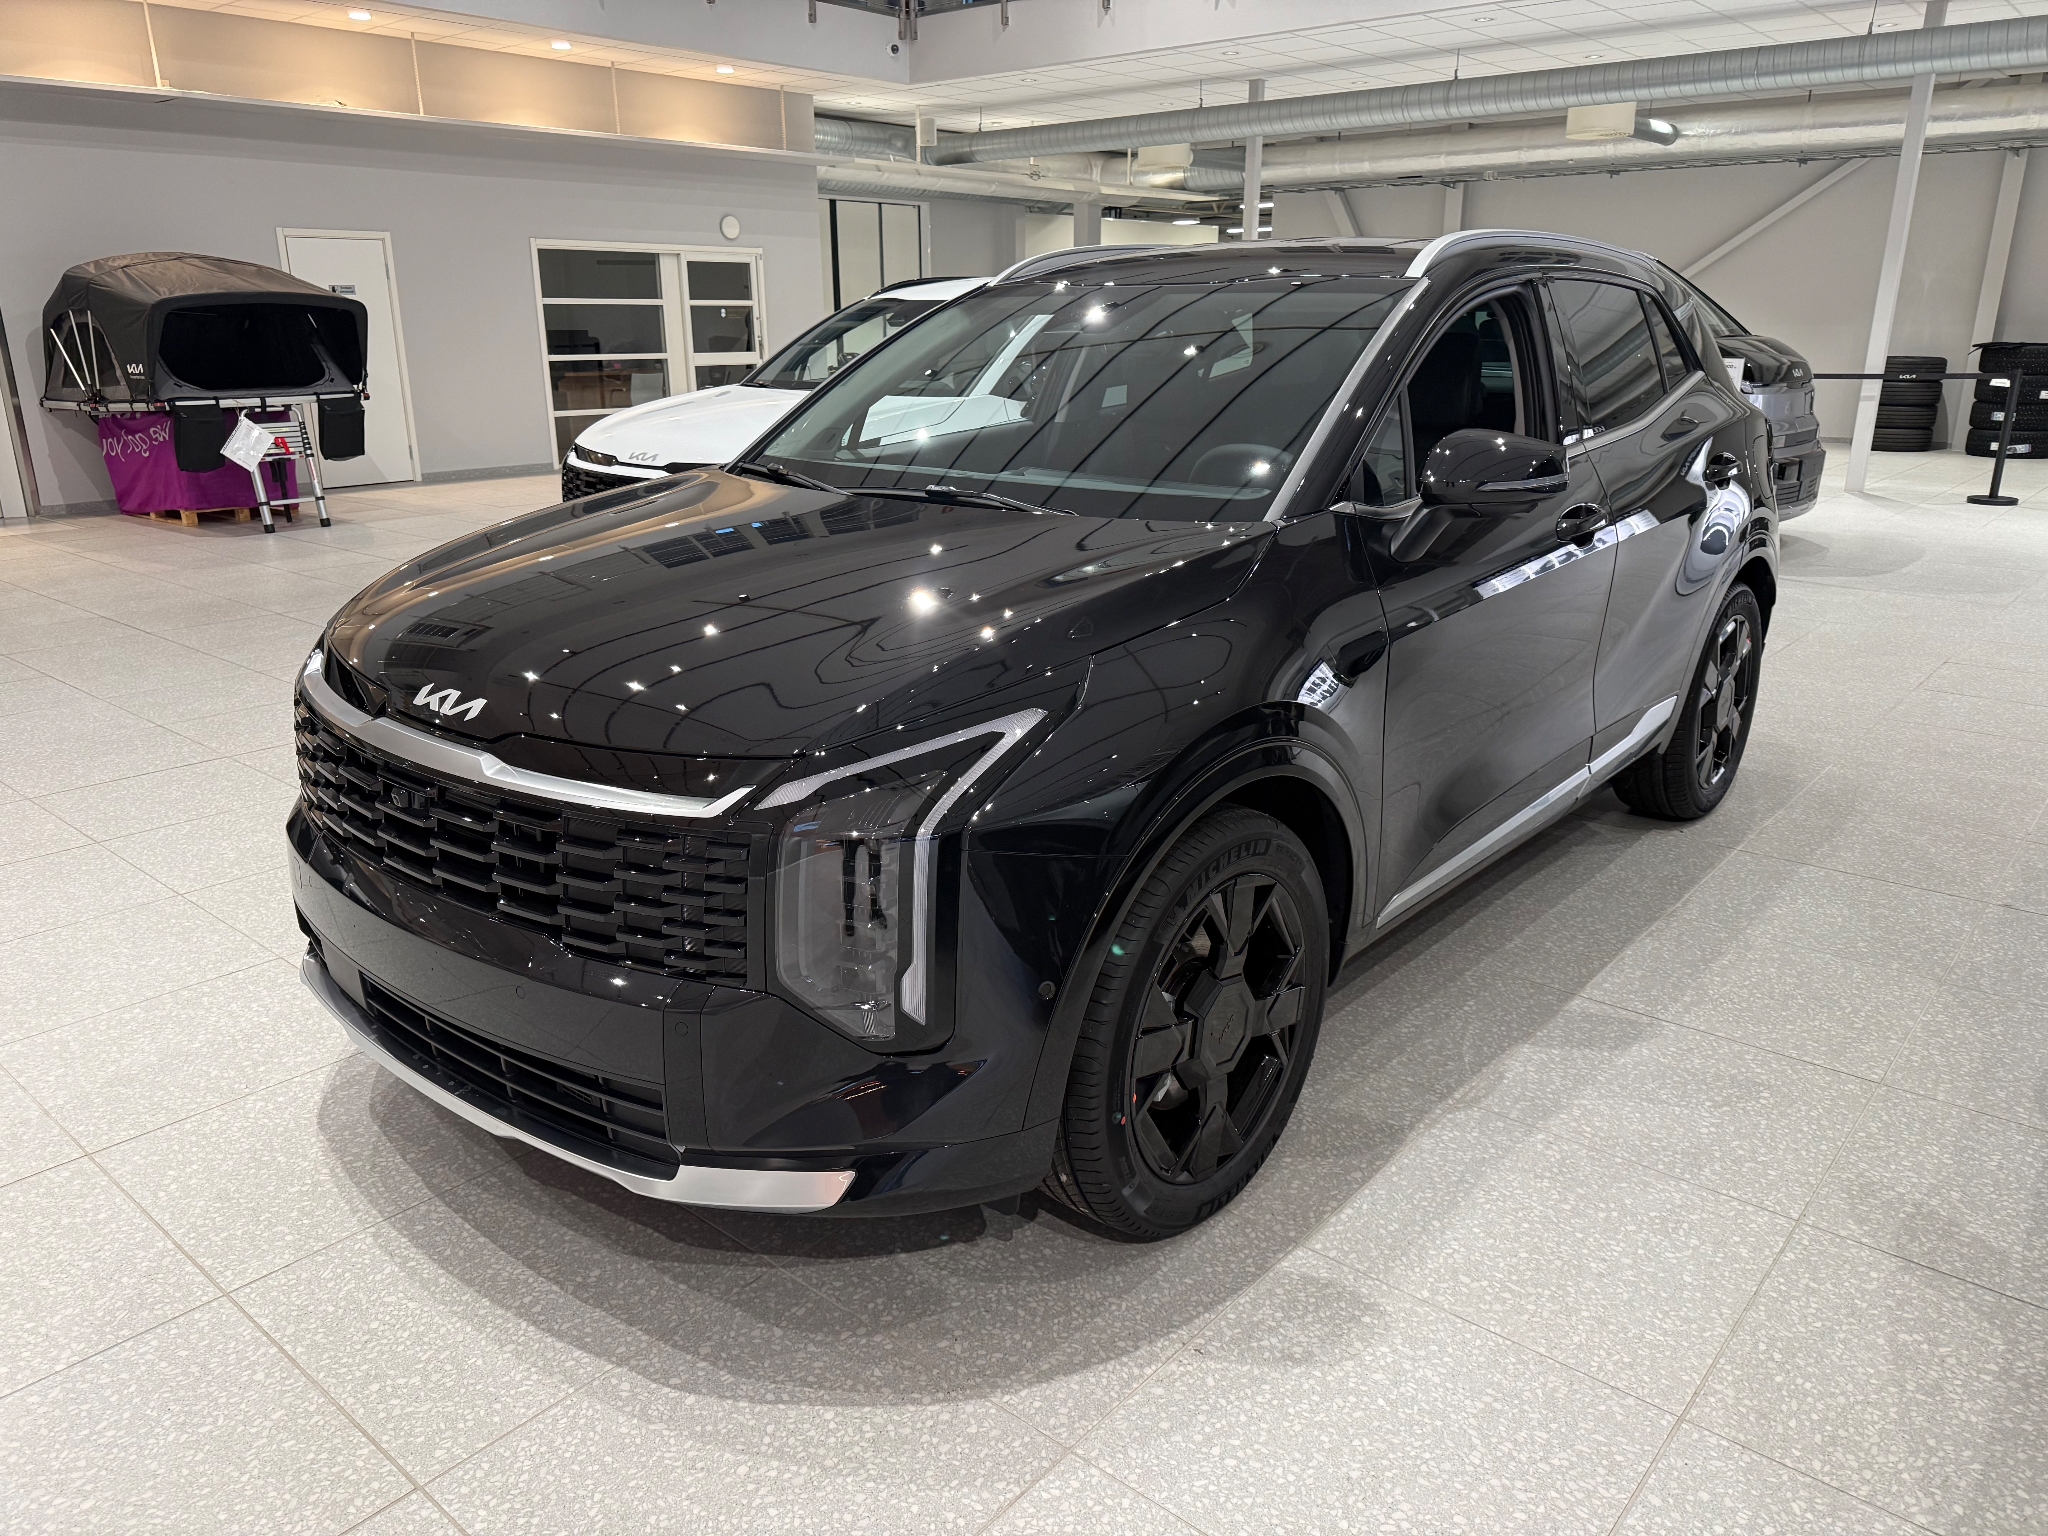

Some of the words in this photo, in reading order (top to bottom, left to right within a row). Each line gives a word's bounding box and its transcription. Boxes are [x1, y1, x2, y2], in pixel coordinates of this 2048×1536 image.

[126, 363, 144, 374] KIA
[628, 452, 660, 463] KIA
[412, 682, 488, 722] KIA
[1186, 839, 1269, 902] MICHELIN
